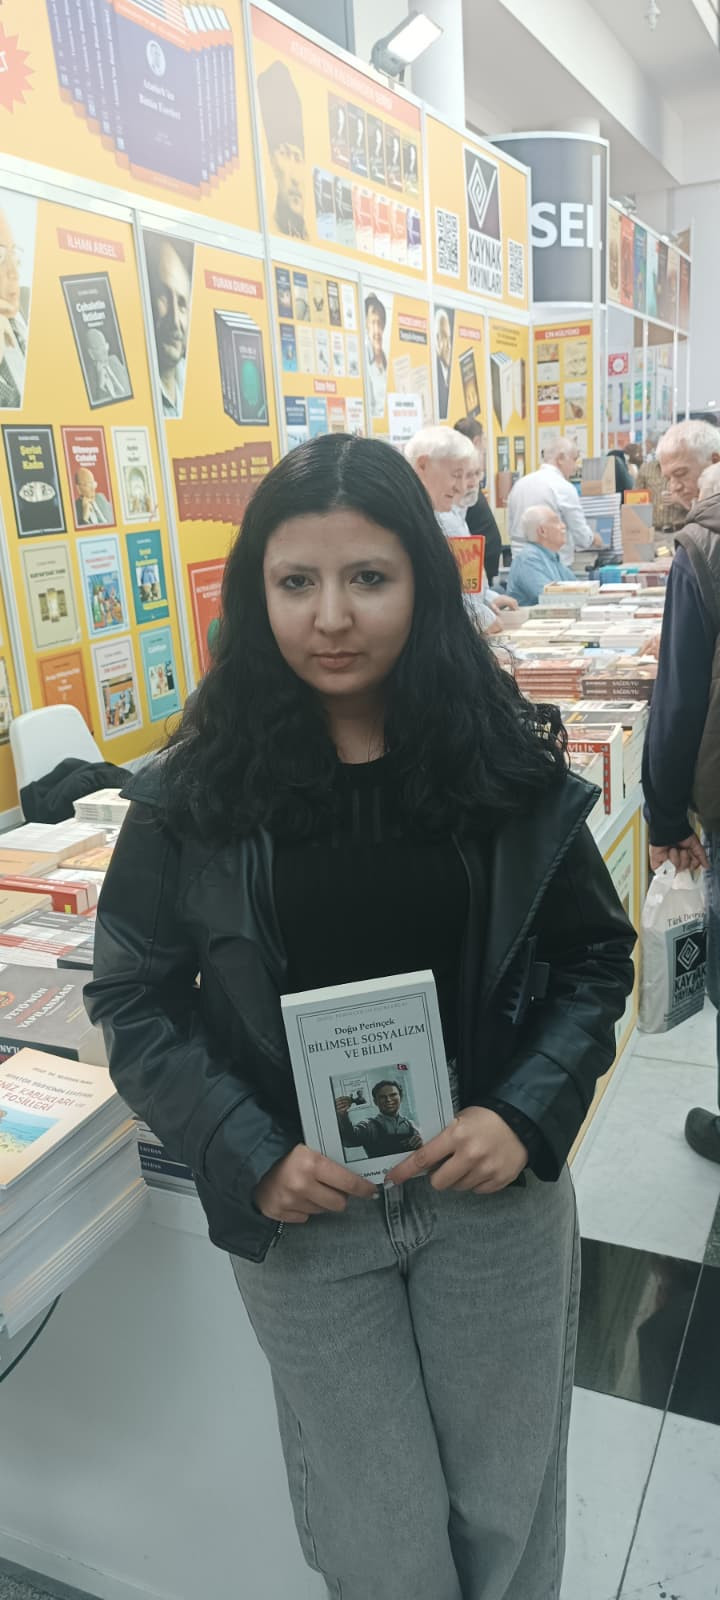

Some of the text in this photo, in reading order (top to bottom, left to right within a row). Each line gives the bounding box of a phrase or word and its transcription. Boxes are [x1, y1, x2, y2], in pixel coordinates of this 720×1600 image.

[93, 240, 119, 258] ARSEL
[468, 231, 502, 271] KAYNAK
[469, 264, 502, 295] YAYINLARI
[334, 1017, 396, 1035] Doğu Perinçek
[308, 1023, 425, 1054] BİLİMSEL SOSYALİZM
[344, 1042, 393, 1059] VE BİLİM
[2, 1093, 54, 1112] FOSİLLERİ
